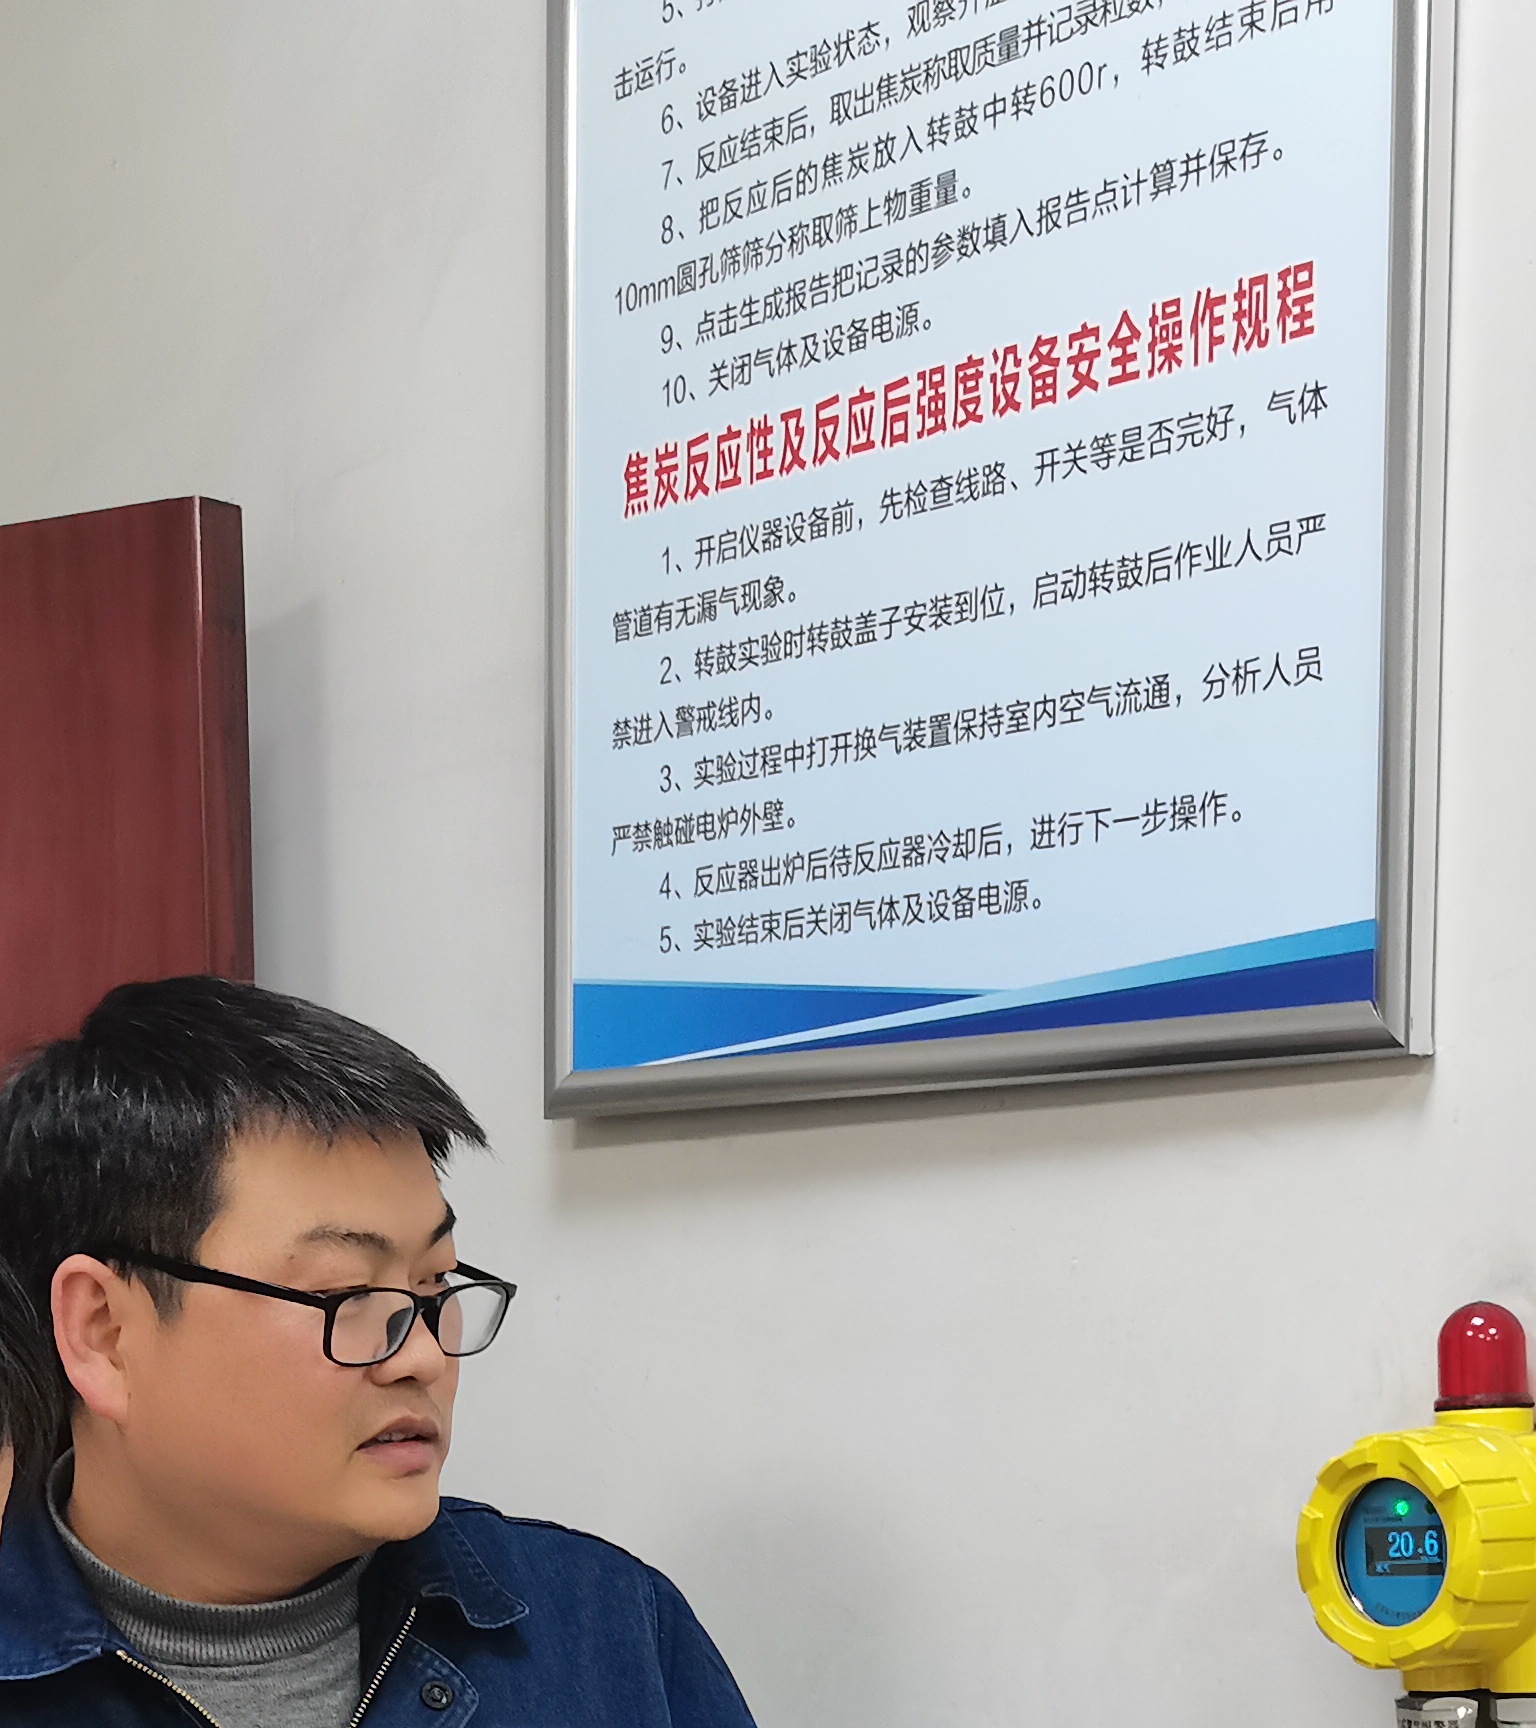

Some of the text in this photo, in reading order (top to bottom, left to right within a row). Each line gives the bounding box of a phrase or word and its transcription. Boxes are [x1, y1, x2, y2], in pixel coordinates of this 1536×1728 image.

[614, 47, 686, 101] 击运行。
[662, 301, 931, 407] 10、关闭气体及设备电源。
[623, 260, 1316, 518] 焦炭反应性及反应后强度设备安全操作规程
[613, 574, 796, 643] 管道有无漏气现象。
[612, 691, 772, 750] 禁进入警戒线内。
[611, 798, 795, 856] 严禁触碰电炉外壁。
[660, 879, 1041, 953] 5、实验结束后关闭气体及设备电源。
[1388, 1530, 1439, 1558] 20.6
